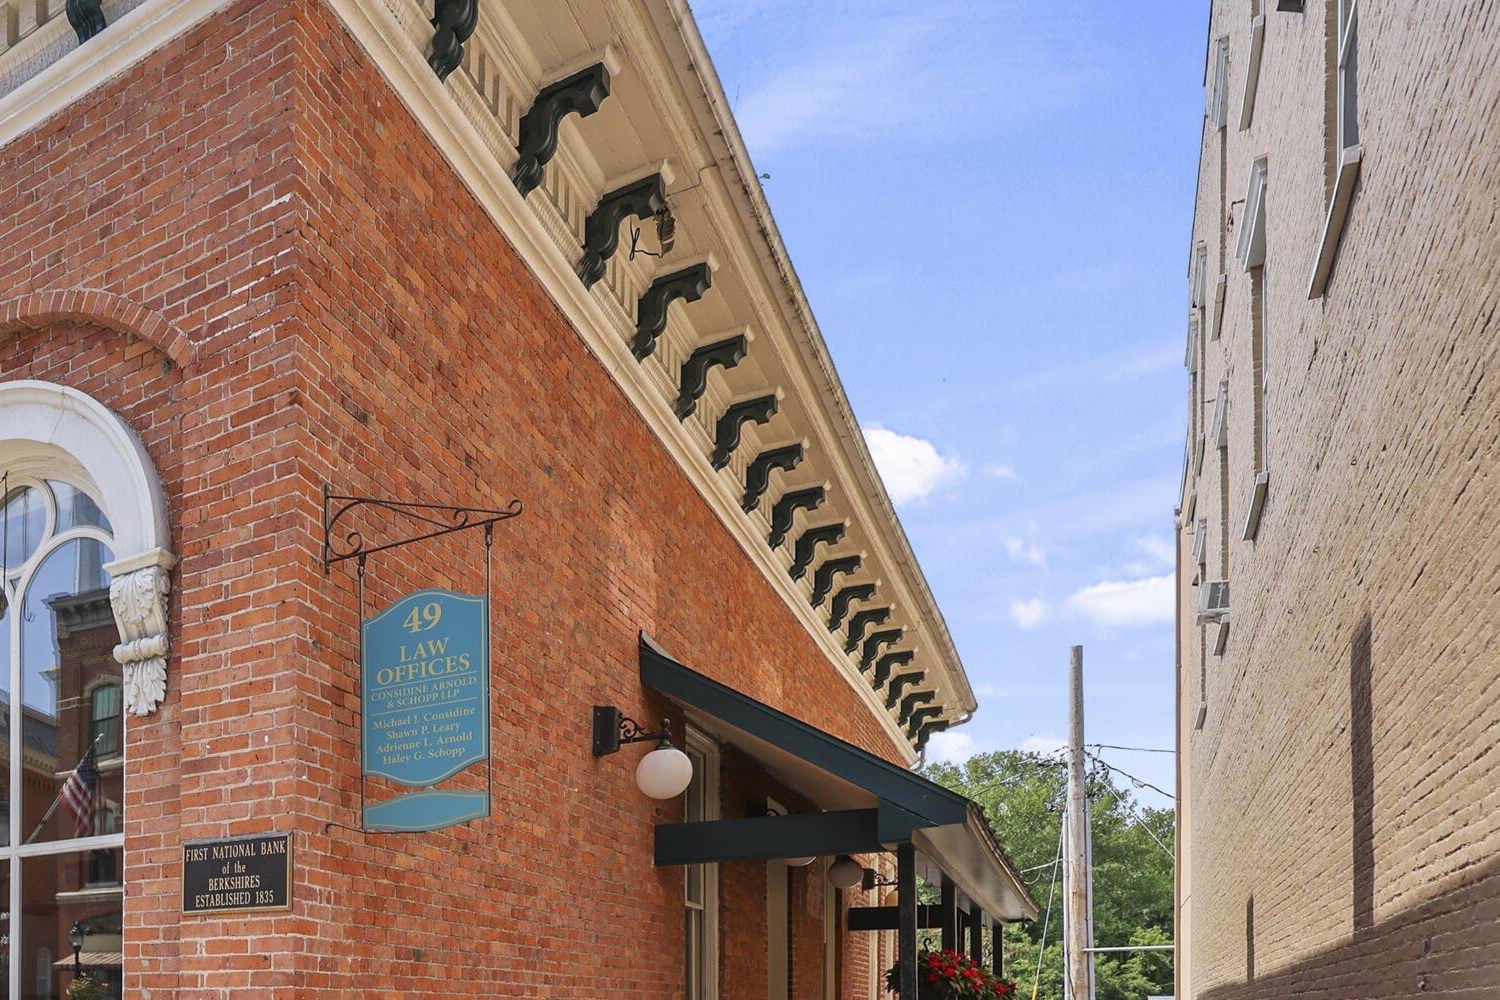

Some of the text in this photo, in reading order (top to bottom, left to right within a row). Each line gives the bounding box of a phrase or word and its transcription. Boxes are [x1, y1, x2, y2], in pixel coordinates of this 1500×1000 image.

[403, 602, 443, 633] 49
[399, 638, 449, 663] LAW
[376, 654, 471, 686] OFFICES
[371, 676, 477, 702] CONSIDINE ARNOLD
[386, 689, 461, 709] & SCHOPP LLP
[373, 715, 411, 730] Michael
[423, 707, 476, 721] Considine
[376, 731, 473, 754] Adrienne L. Arnold
[386, 722, 461, 740] Shawn P. Leary
[383, 746, 466, 766] Haley G. Schopp
[185, 840, 287, 863] FIRST NATIONAL BANK
[222, 861, 247, 875] of the
[208, 875, 261, 892] BERKSHIRES
[195, 890, 275, 909] ESTABLISHED 1835
